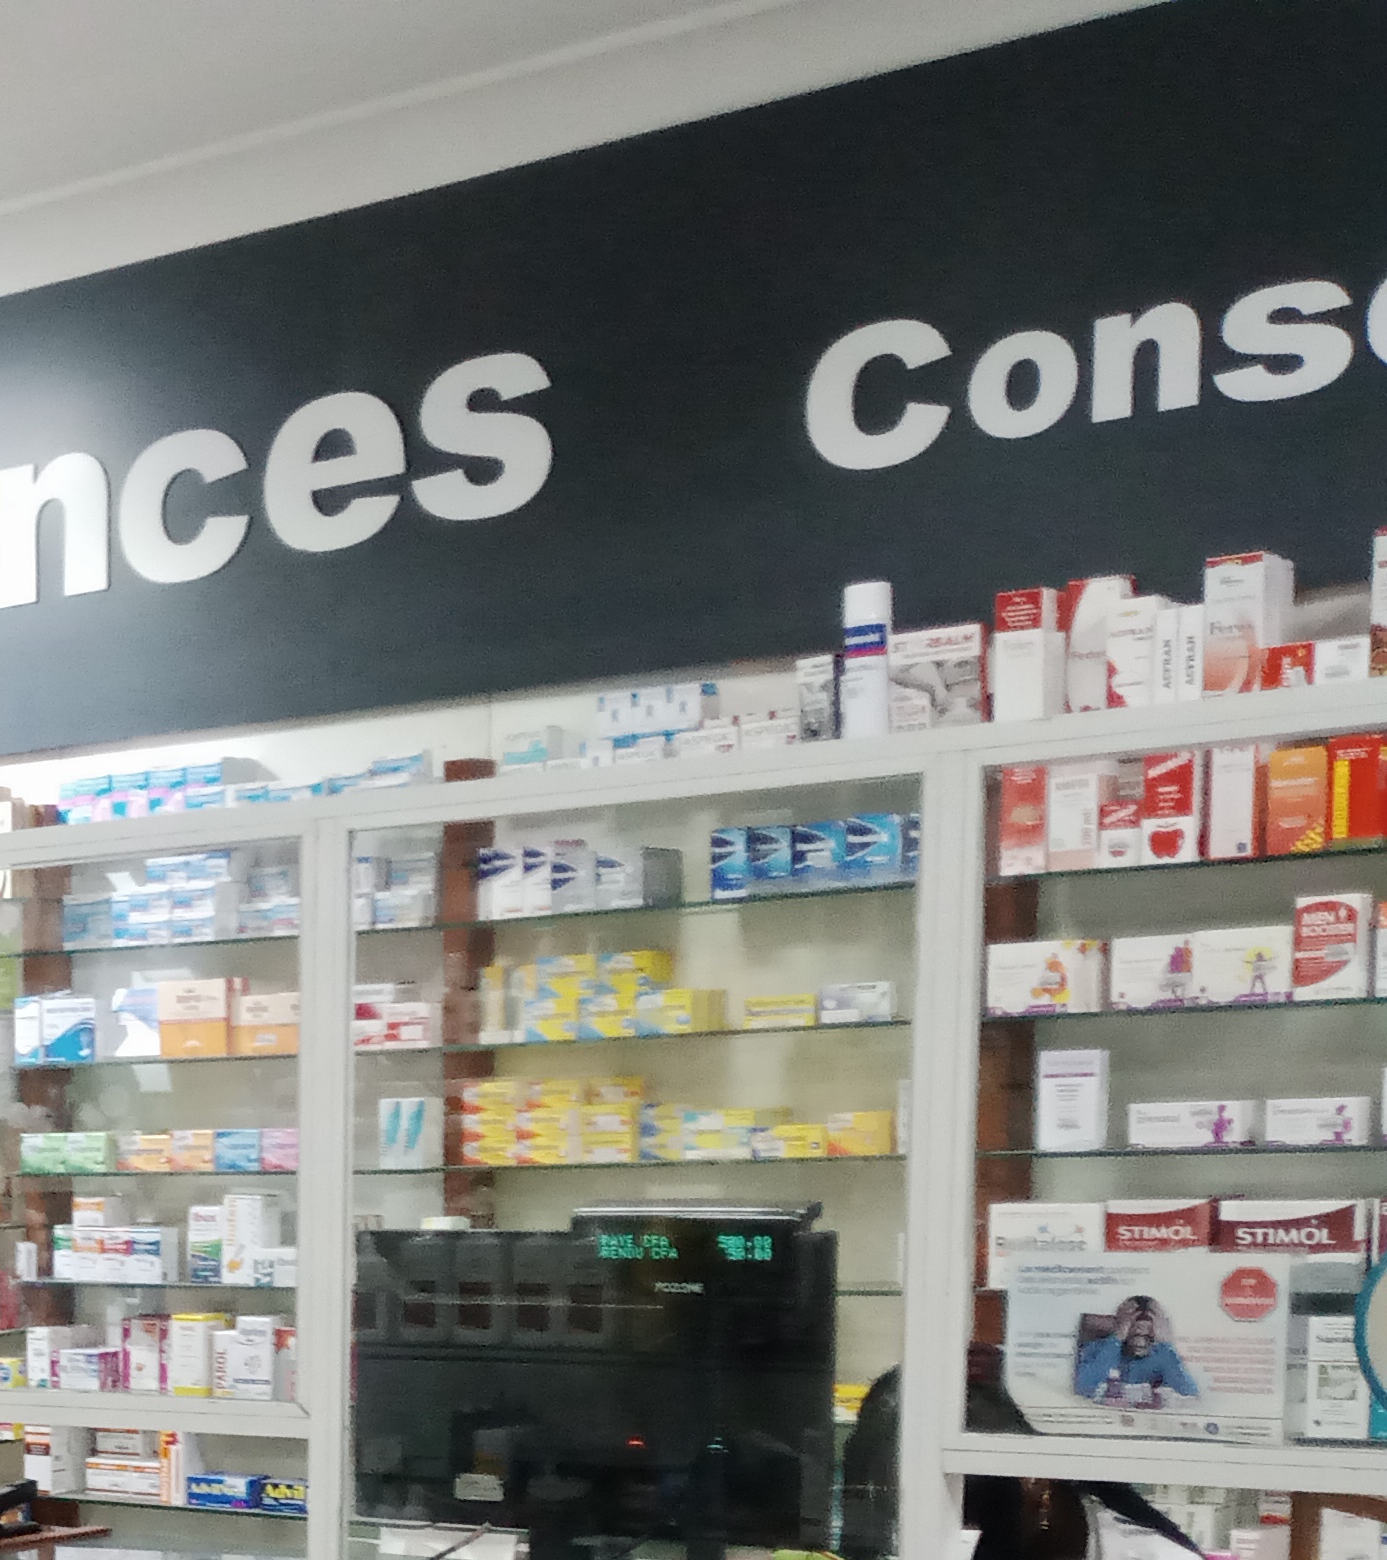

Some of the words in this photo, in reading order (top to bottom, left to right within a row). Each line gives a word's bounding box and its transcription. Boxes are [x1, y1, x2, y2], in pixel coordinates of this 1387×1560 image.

[806, 277, 1387, 470] Cons
[1116, 1222, 1201, 1242] STIMOL
[1234, 1223, 1338, 1246] STIMOL
